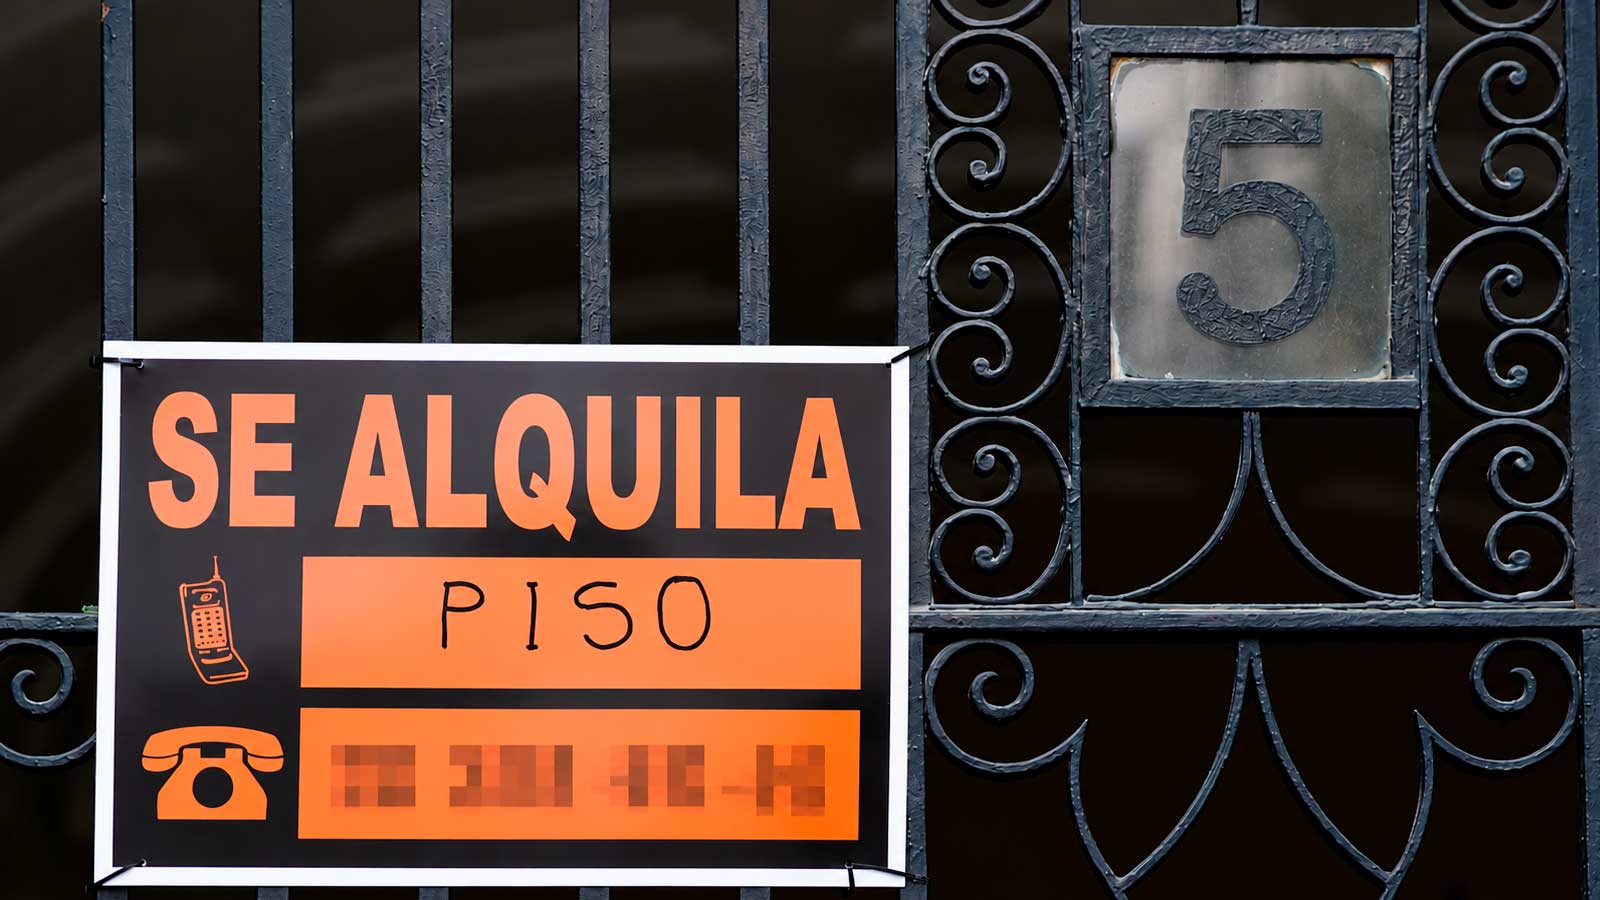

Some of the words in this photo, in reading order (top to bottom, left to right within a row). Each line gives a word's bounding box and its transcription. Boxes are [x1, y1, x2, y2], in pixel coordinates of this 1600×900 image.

[1176, 107, 1336, 346] 5
[148, 391, 296, 529] SE
[334, 393, 862, 542] ALQUILA
[441, 575, 711, 651] PISO
